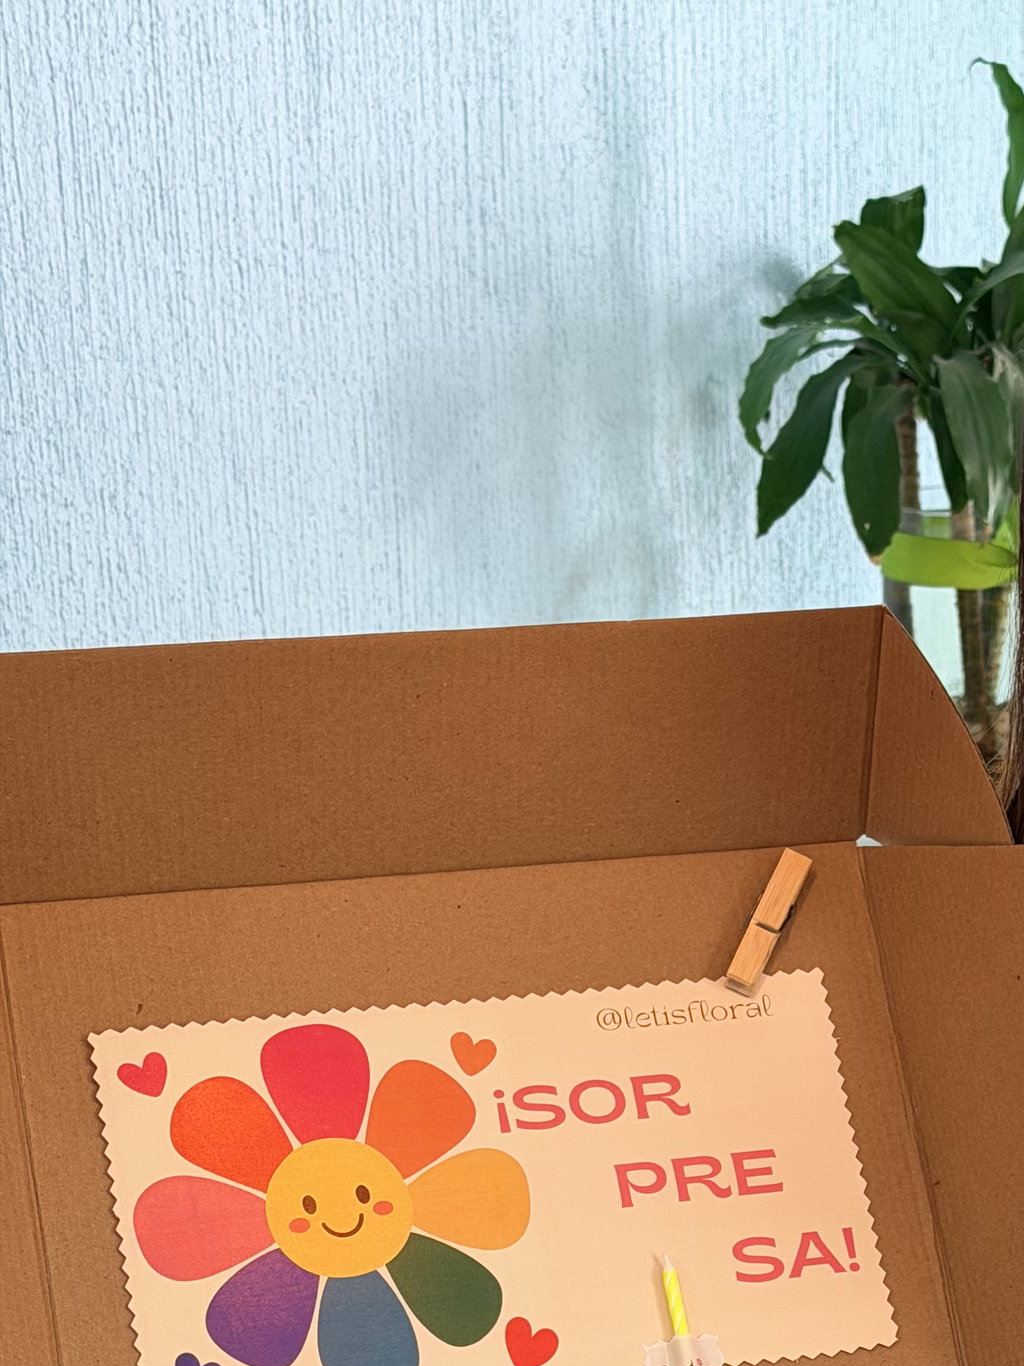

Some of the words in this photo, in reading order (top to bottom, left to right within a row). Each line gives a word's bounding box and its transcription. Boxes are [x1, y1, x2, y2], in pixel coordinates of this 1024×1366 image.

[596, 993, 775, 1031] @letisfloral
[493, 1073, 692, 1134] ¡SOR
[613, 1148, 784, 1208] PRE
[732, 1227, 861, 1283] SA!
